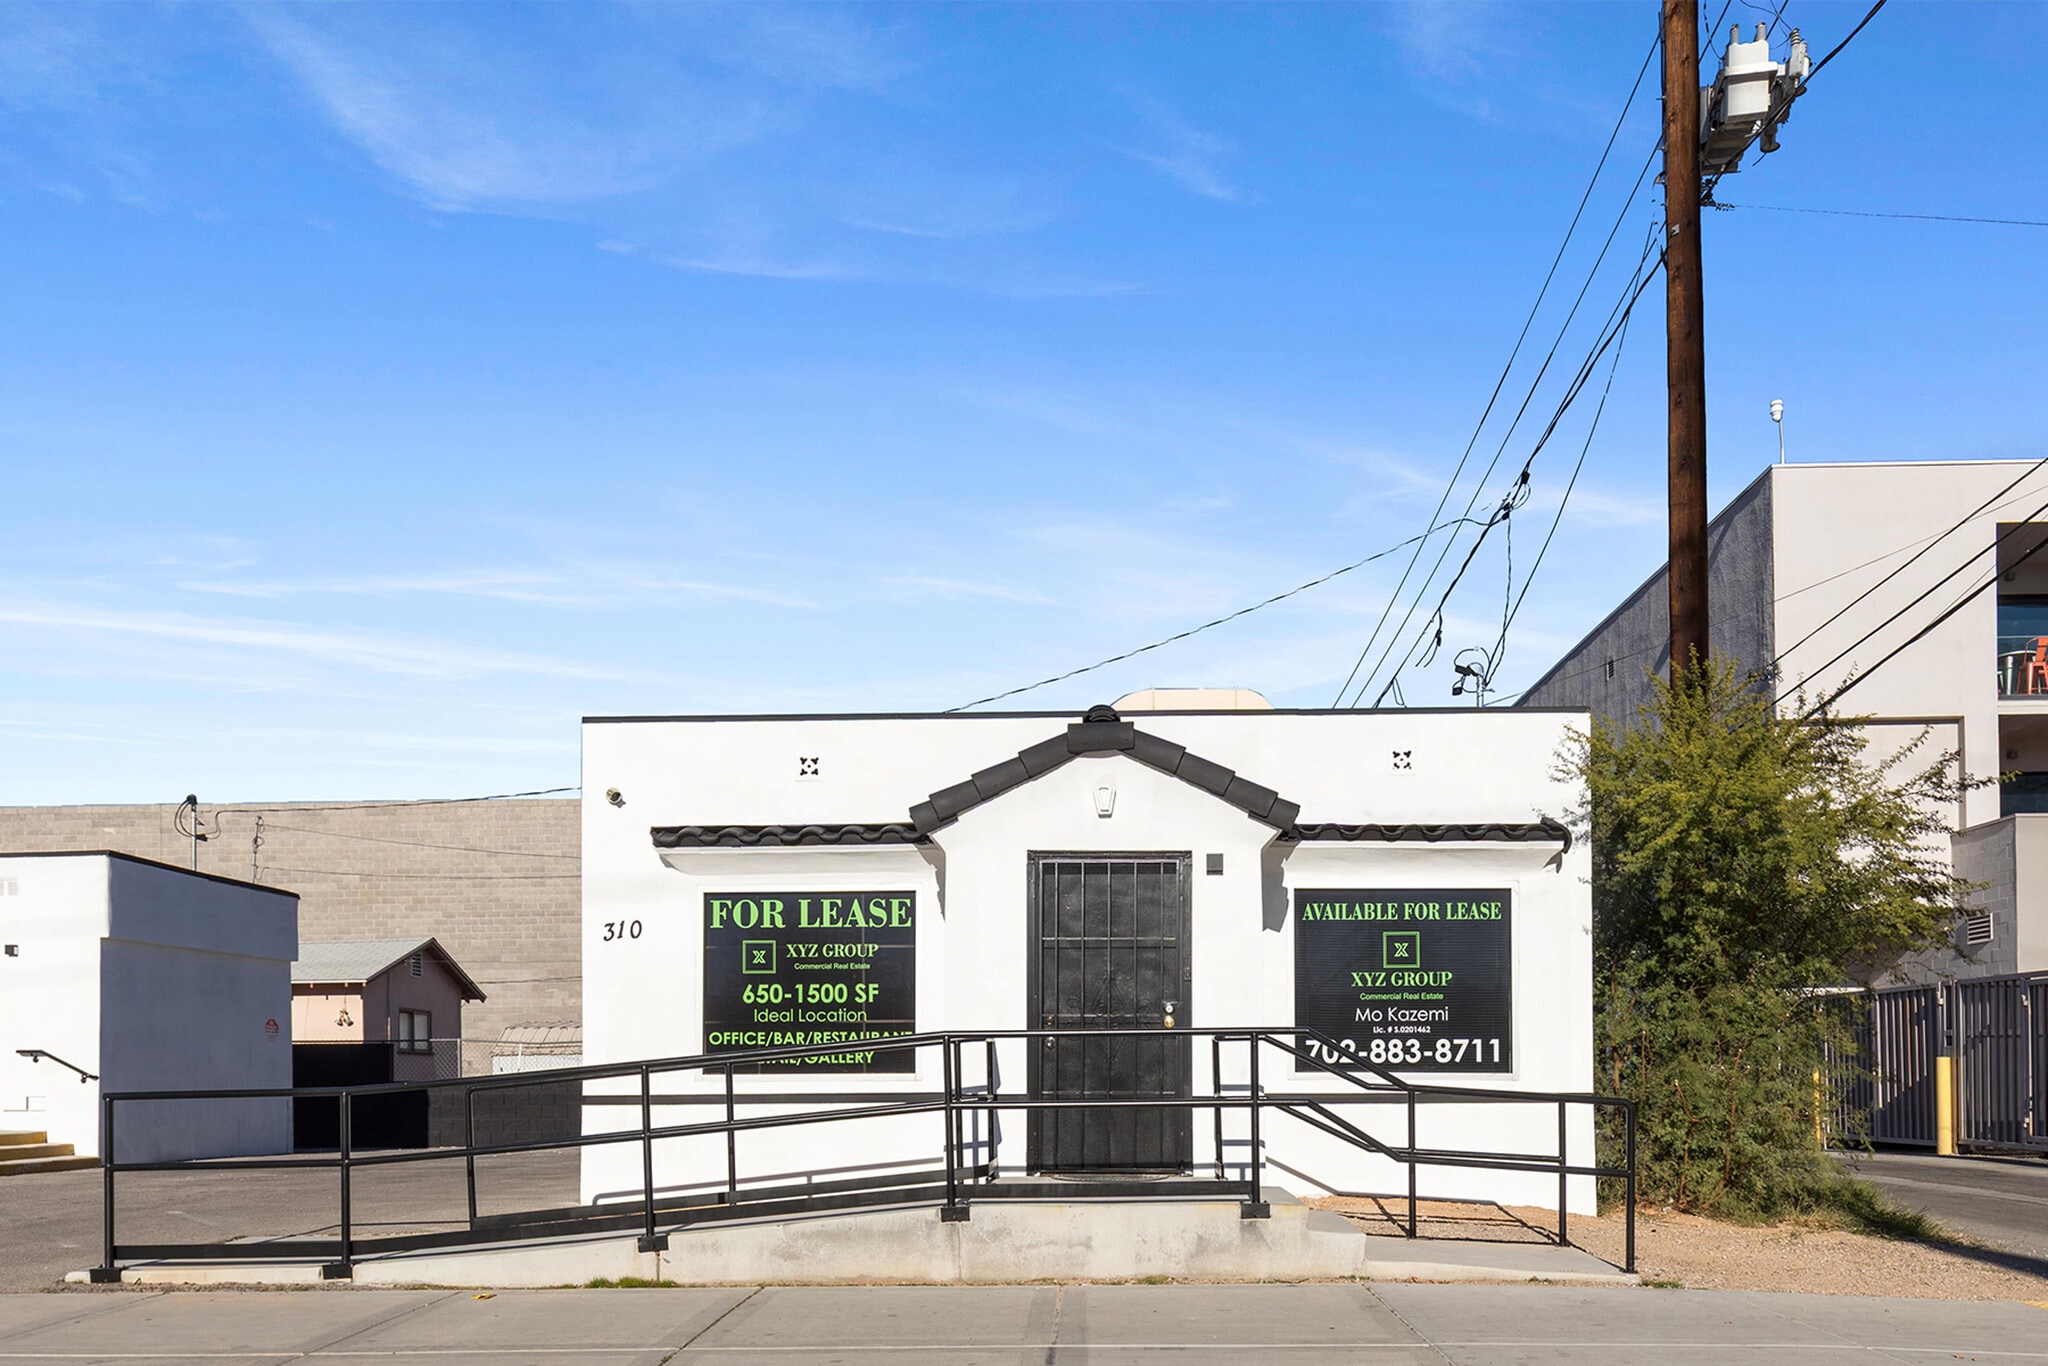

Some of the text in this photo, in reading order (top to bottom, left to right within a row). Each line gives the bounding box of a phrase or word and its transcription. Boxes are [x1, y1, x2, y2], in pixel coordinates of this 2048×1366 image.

[710, 898, 911, 928] FOR LEASE
[1302, 902, 1501, 920] AVAILABLE FOR LEASE
[604, 920, 641, 941] 310
[787, 944, 878, 957] XYZ GROUP
[1351, 972, 1452, 986] XYZ GROUP
[743, 983, 878, 1003] 650-1500 SF
[1360, 993, 1401, 1001] Commercial
[755, 1009, 866, 1022] Ideal Location
[1356, 1007, 1448, 1021] Mo Kazemi
[708, 1031, 913, 1046] OFFICE/BAR/RESTAUR
[1305, 1038, 1500, 1065] 702-883-8711
